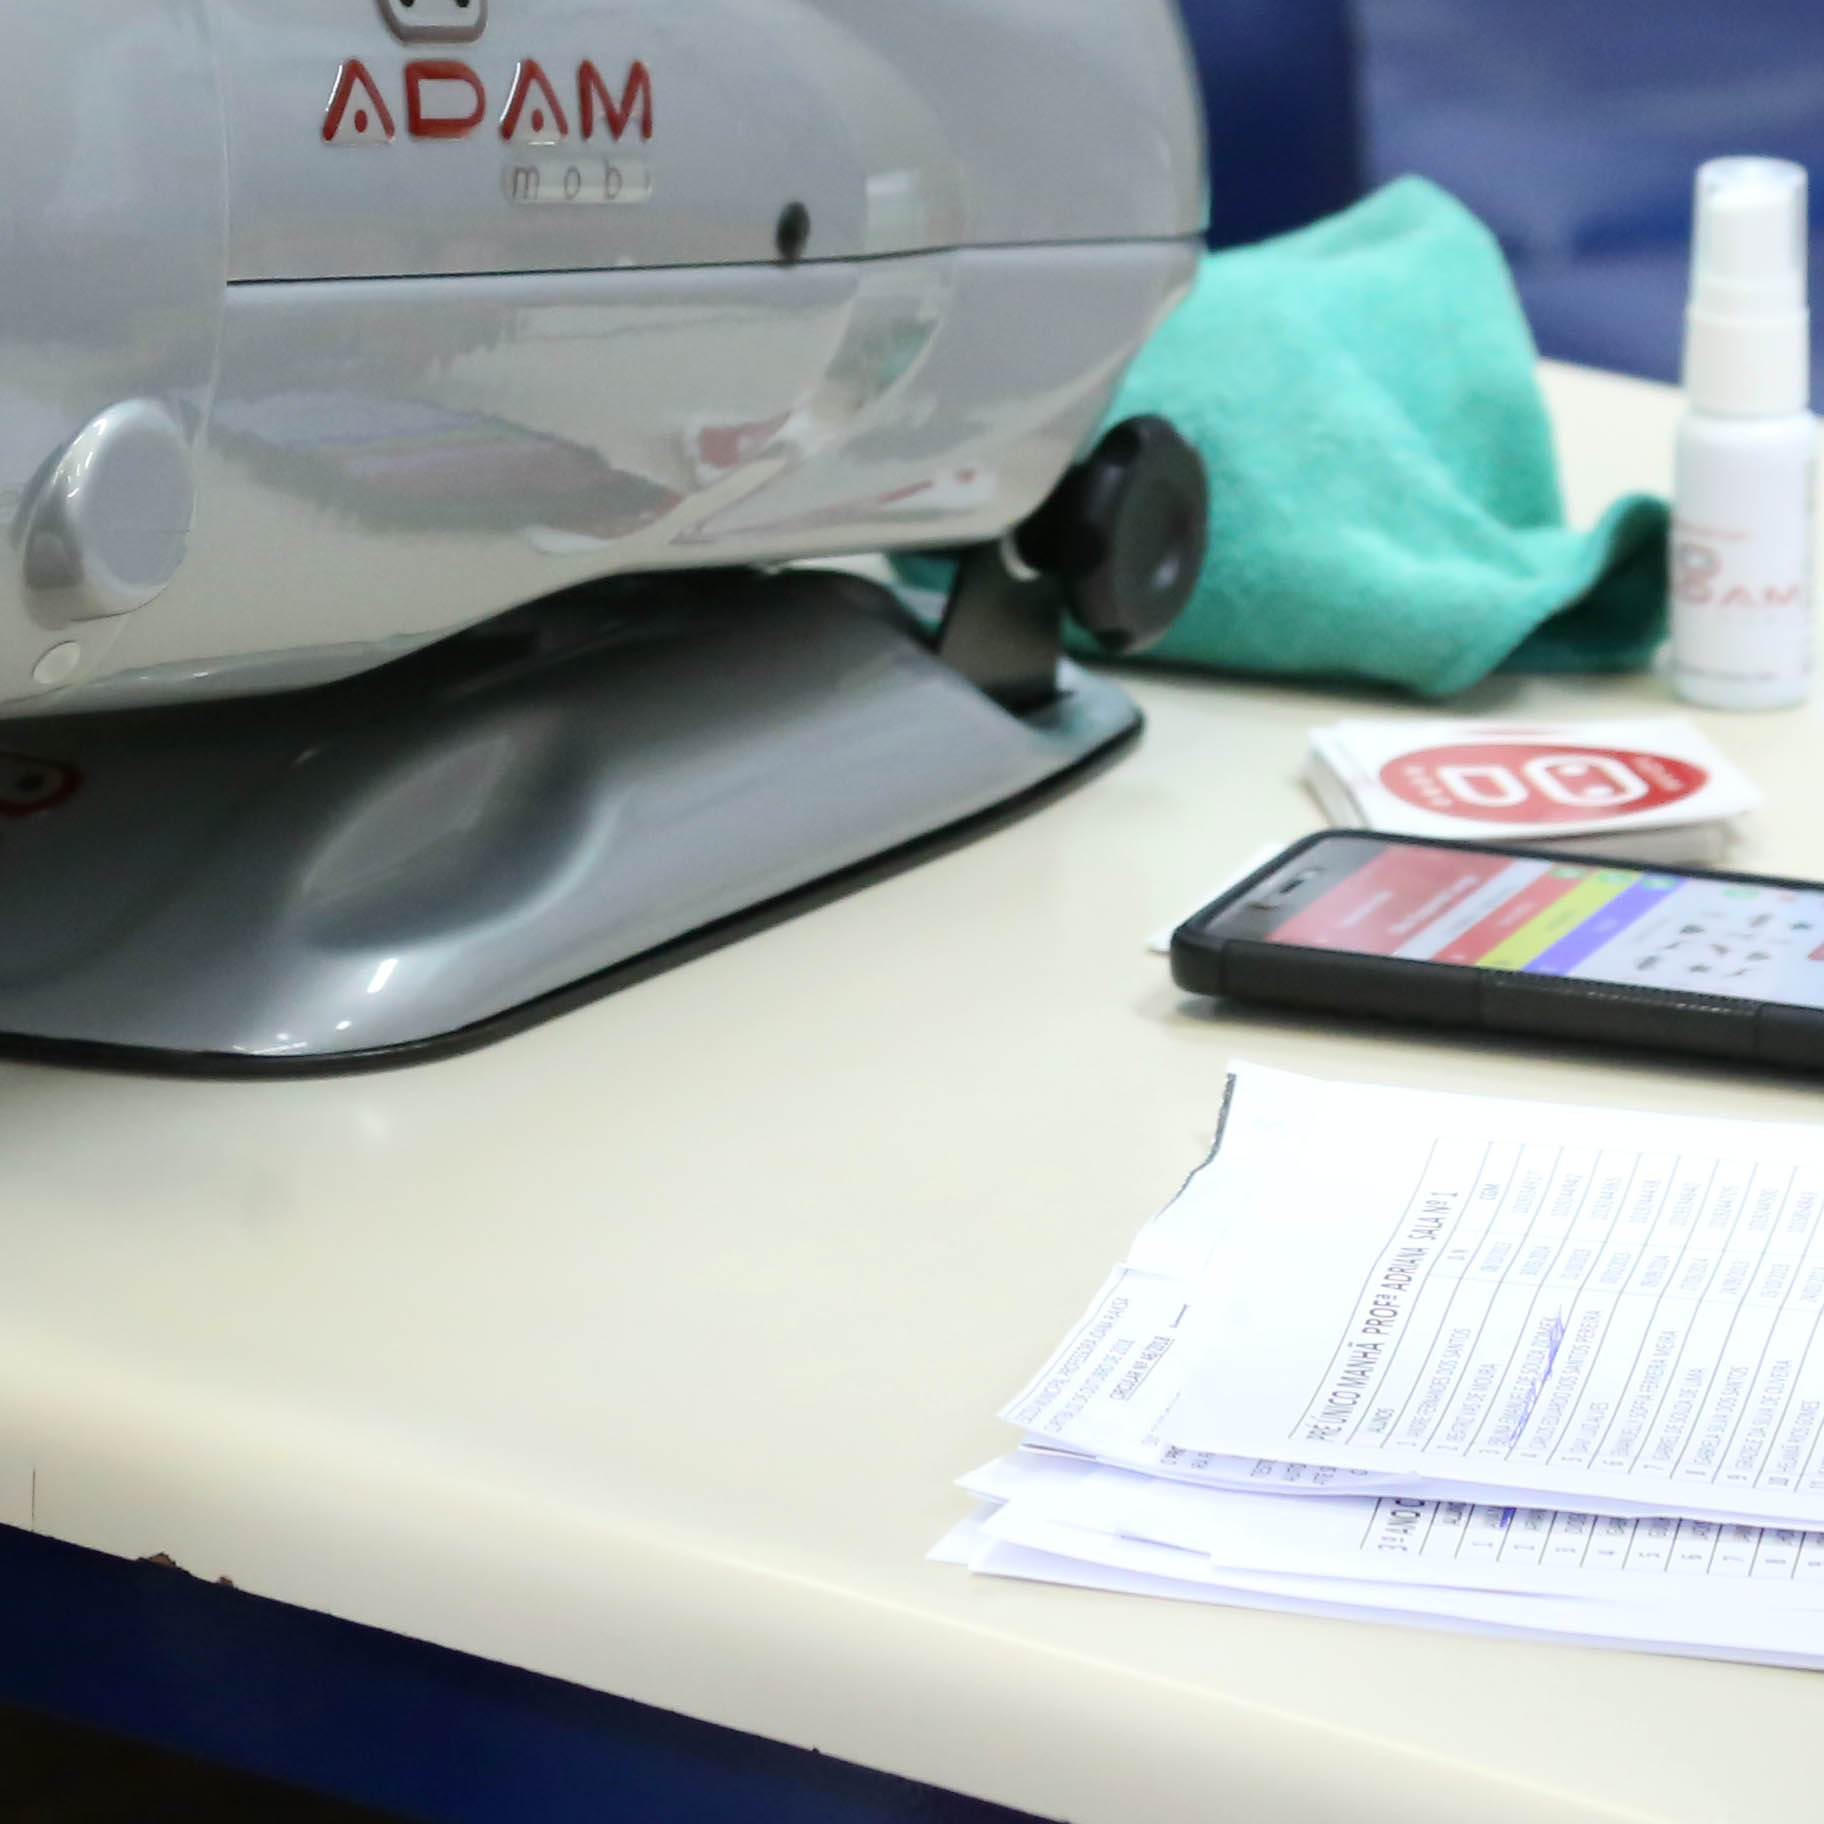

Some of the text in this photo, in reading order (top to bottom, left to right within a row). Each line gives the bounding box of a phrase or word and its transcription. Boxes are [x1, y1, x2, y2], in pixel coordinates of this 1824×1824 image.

[322, 57, 653, 142] ADAM
[1421, 1200, 1451, 1214] Nº
[1408, 1217, 1445, 1240] SALA
[1381, 1248, 1427, 1291] ADRIANA
[1361, 1294, 1399, 1335] PROFª
[1574, 1310, 1601, 1343] PEREIRA
[1442, 1328, 1471, 1358] SANTOS
[1652, 1330, 1678, 1356] MEIRA
[1337, 1342, 1384, 1388] MANHÃ
[1435, 1359, 1458, 1375] DOS
[1520, 1350, 1547, 1374] SOUZA
[1561, 1344, 1591, 1375] SANTOS
[1471, 1363, 1498, 1391] MOURA
[1721, 1366, 1749, 1396] SANTOS
[1764, 1360, 1792, 1394] OLIVEIRA
[1311, 1390, 1361, 1424] ÚNICO
[1668, 1400, 1693, 1423] SOUZA
[1306, 1424, 1342, 1440] PRÉ
